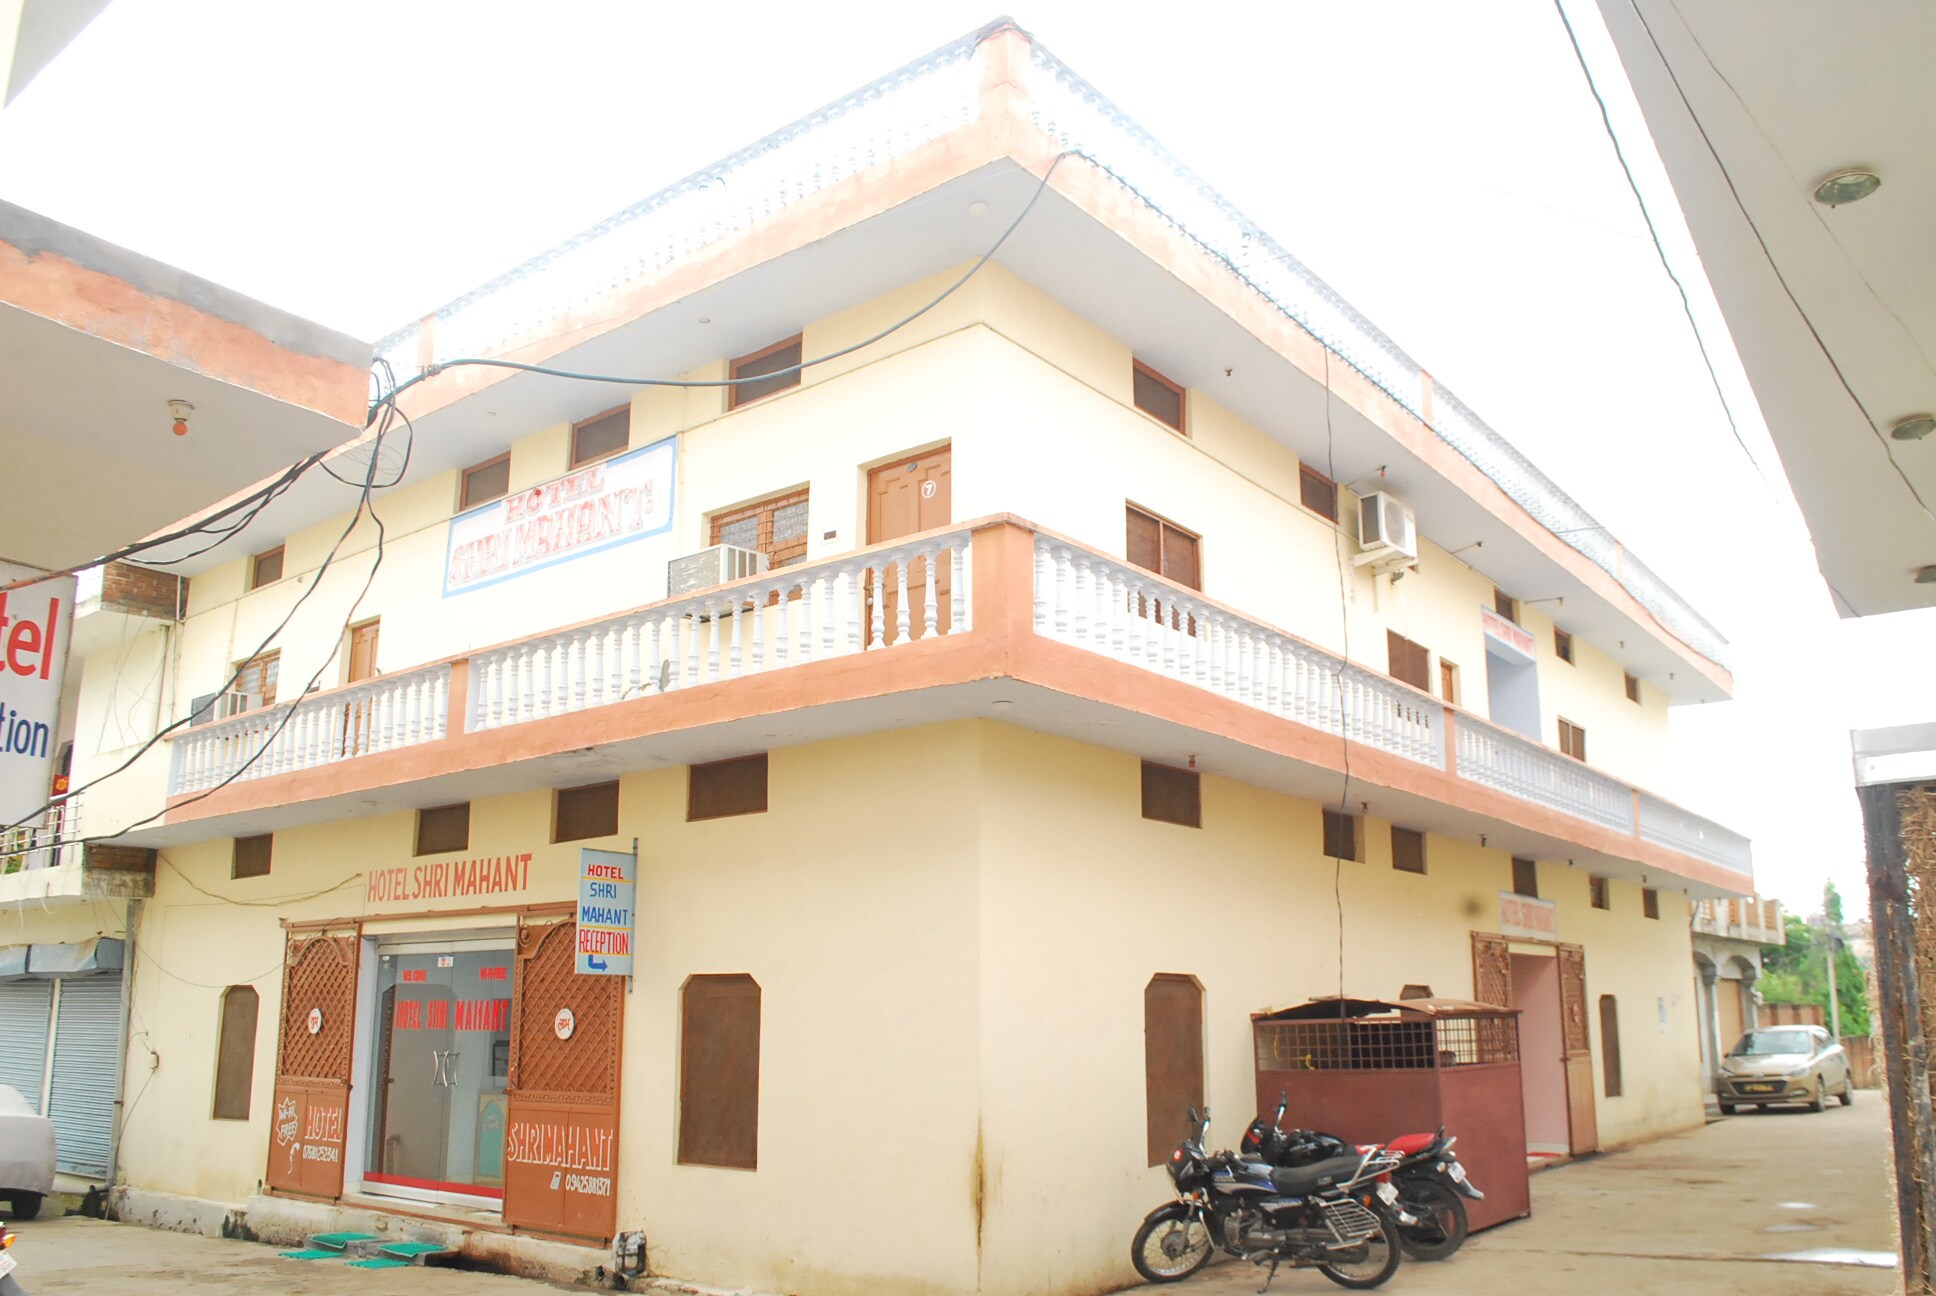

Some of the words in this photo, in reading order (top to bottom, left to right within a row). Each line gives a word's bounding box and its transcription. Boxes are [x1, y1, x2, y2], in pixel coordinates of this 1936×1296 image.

[504, 467, 605, 524] HOTEL
[449, 526, 510, 585] SHRI
[367, 867, 410, 902] HOTEL
[412, 862, 450, 899] SHRI
[453, 853, 532, 897] MAHANT
[588, 864, 624, 880] HOTEL
[590, 882, 617, 899] SHRI
[581, 905, 628, 926] MAHANT
[579, 929, 629, 955] RECEPTION
[395, 1000, 422, 1030] HOTEL
[455, 1000, 509, 1032] MAHANT
